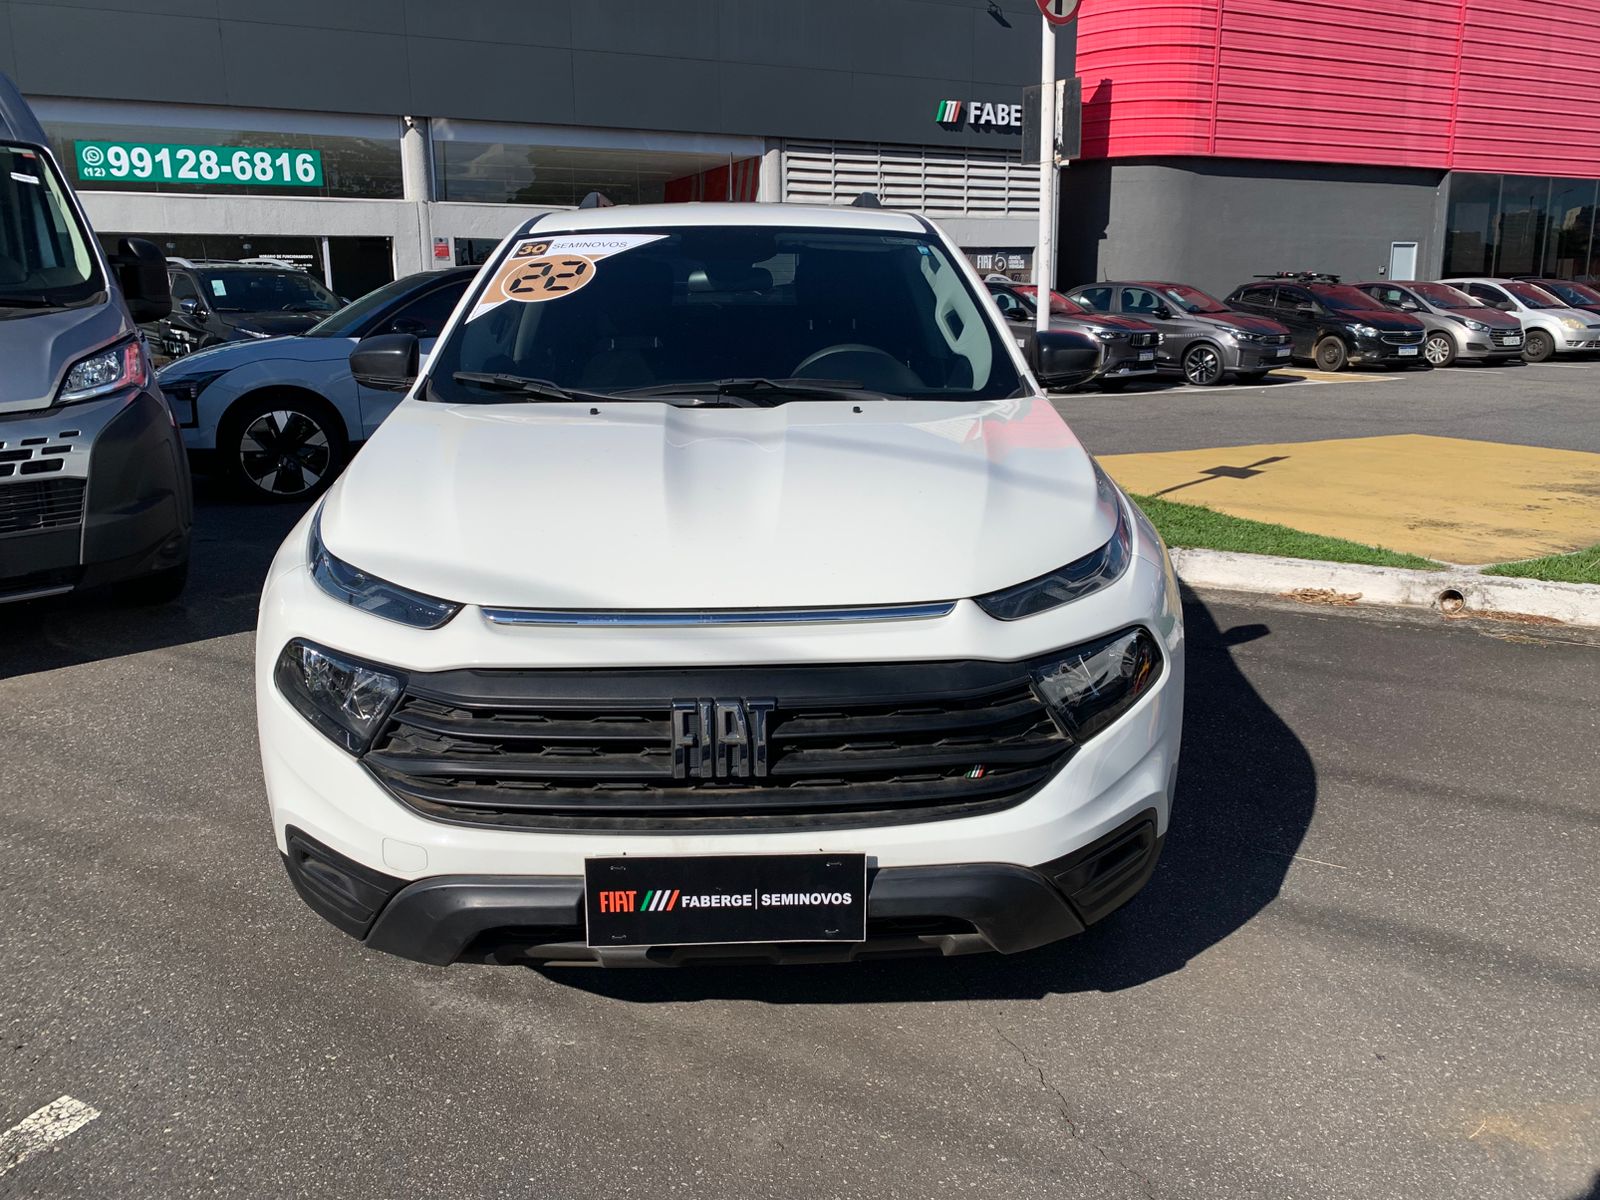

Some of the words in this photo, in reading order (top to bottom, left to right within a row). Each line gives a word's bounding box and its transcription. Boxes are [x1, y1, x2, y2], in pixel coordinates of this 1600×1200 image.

[83, 167, 106, 177] (12)
[106, 145, 316, 183] 99128-6816
[518, 243, 547, 256] 30
[552, 241, 627, 249] SEMINOVOS
[977, 254, 993, 269] FIAT
[509, 260, 588, 293] 22
[671, 696, 778, 779] FIAT
[599, 890, 637, 913] FIAT
[681, 894, 752, 908] FABERGE
[761, 892, 852, 907] SEMINOVOS
